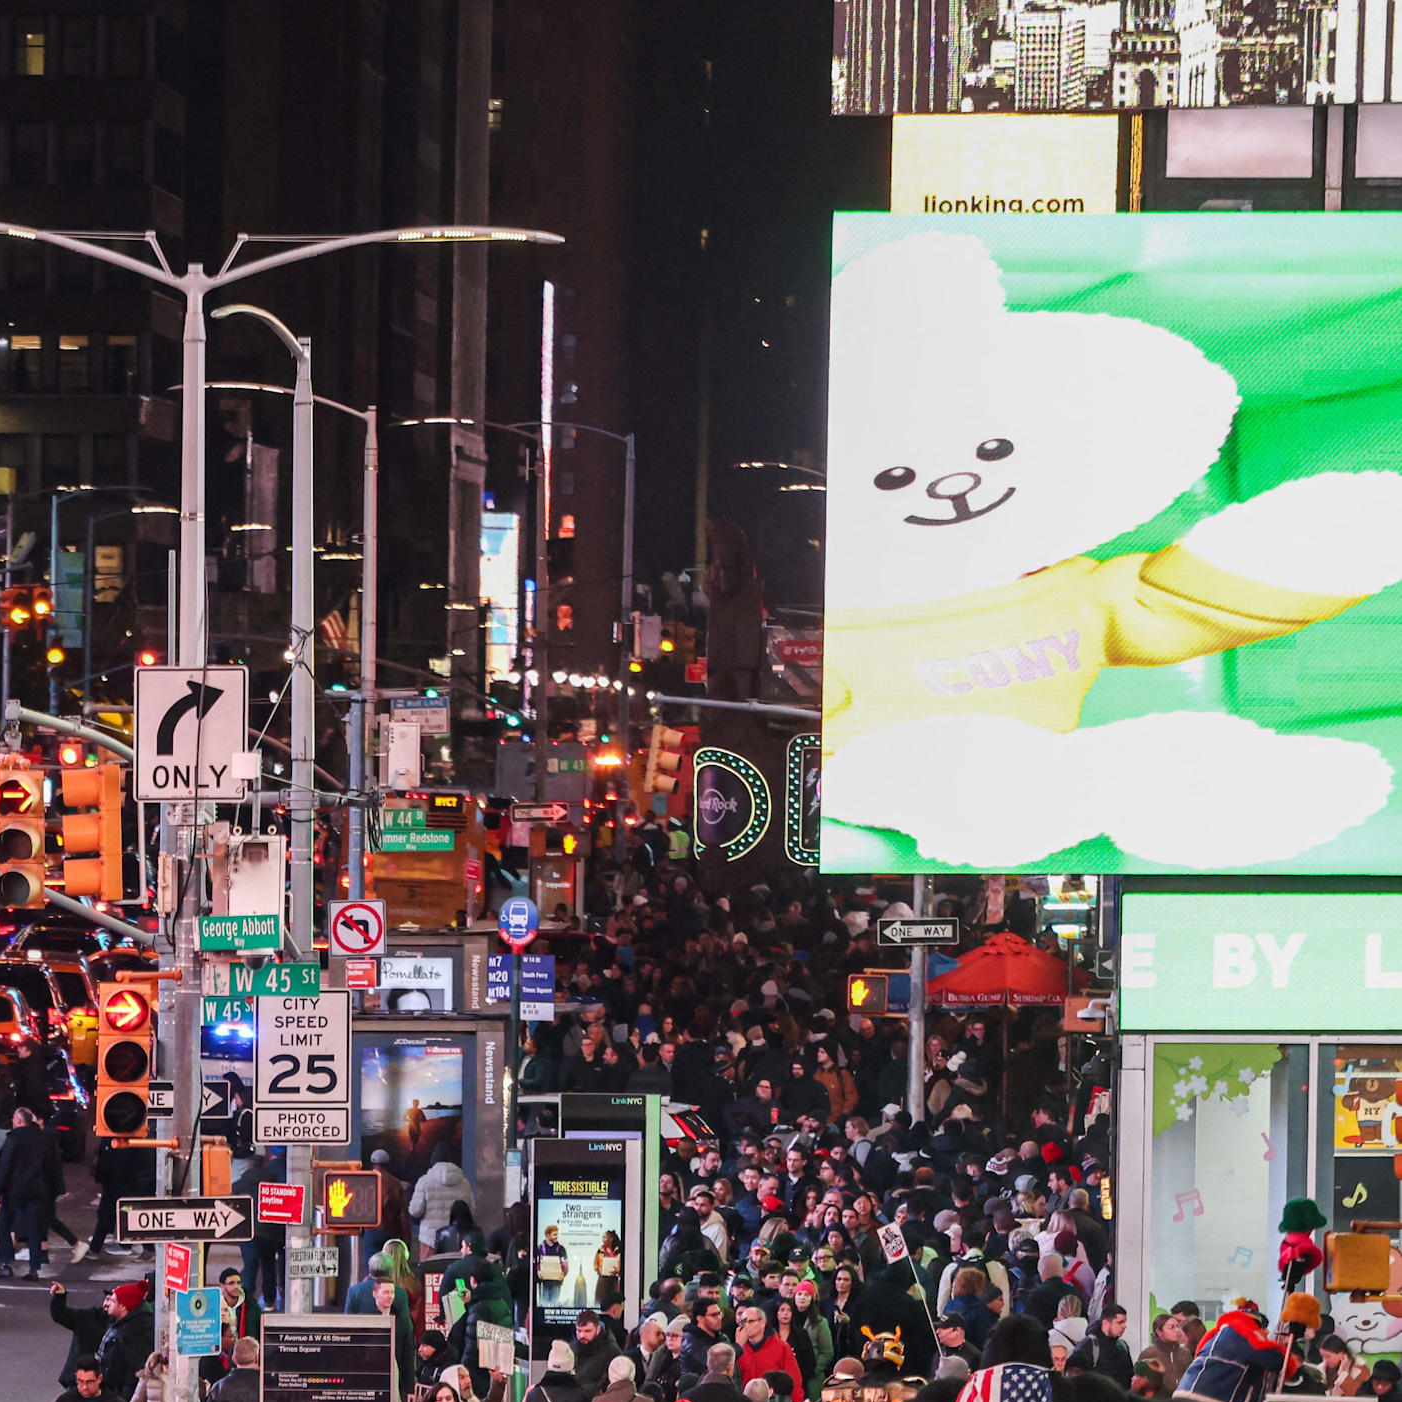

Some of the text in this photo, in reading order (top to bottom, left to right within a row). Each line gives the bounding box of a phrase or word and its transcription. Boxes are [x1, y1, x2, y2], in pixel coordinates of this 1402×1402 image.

[152, 765, 228, 788] ONLY
[385, 812, 394, 826] W
[397, 811, 412, 826] 44
[384, 832, 450, 844] mner Redstone
[202, 917, 275, 942] George Abbott
[890, 926, 947, 938] ONE WAY
[234, 938, 245, 948] Way
[489, 956, 502, 967] M7
[1212, 934, 1307, 988] BY
[235, 968, 316, 993] W 45 St
[472, 954, 481, 1010] Newsstand
[489, 971, 508, 982] M20
[488, 986, 511, 998] M104
[283, 998, 319, 1010] CITY
[205, 1004, 217, 1022] W
[223, 1002, 242, 1022] 45
[275, 1016, 328, 1028] SPEED
[280, 1034, 323, 1046] LIMIT
[268, 1054, 338, 1094] 25
[485, 1041, 494, 1105] Newsstand
[148, 1093, 165, 1106] NE
[278, 1114, 325, 1124] PHOTO
[264, 1126, 340, 1137] ENFORCED
[589, 1143, 622, 1151] LinkNYC
[261, 1186, 296, 1197] NO STANDING
[261, 1196, 283, 1205] Anytime
[565, 1203, 581, 1212] two
[138, 1212, 231, 1228] ONE WAY
[562, 1210, 602, 1220] strangers
[426, 1274, 444, 1286] BEA
